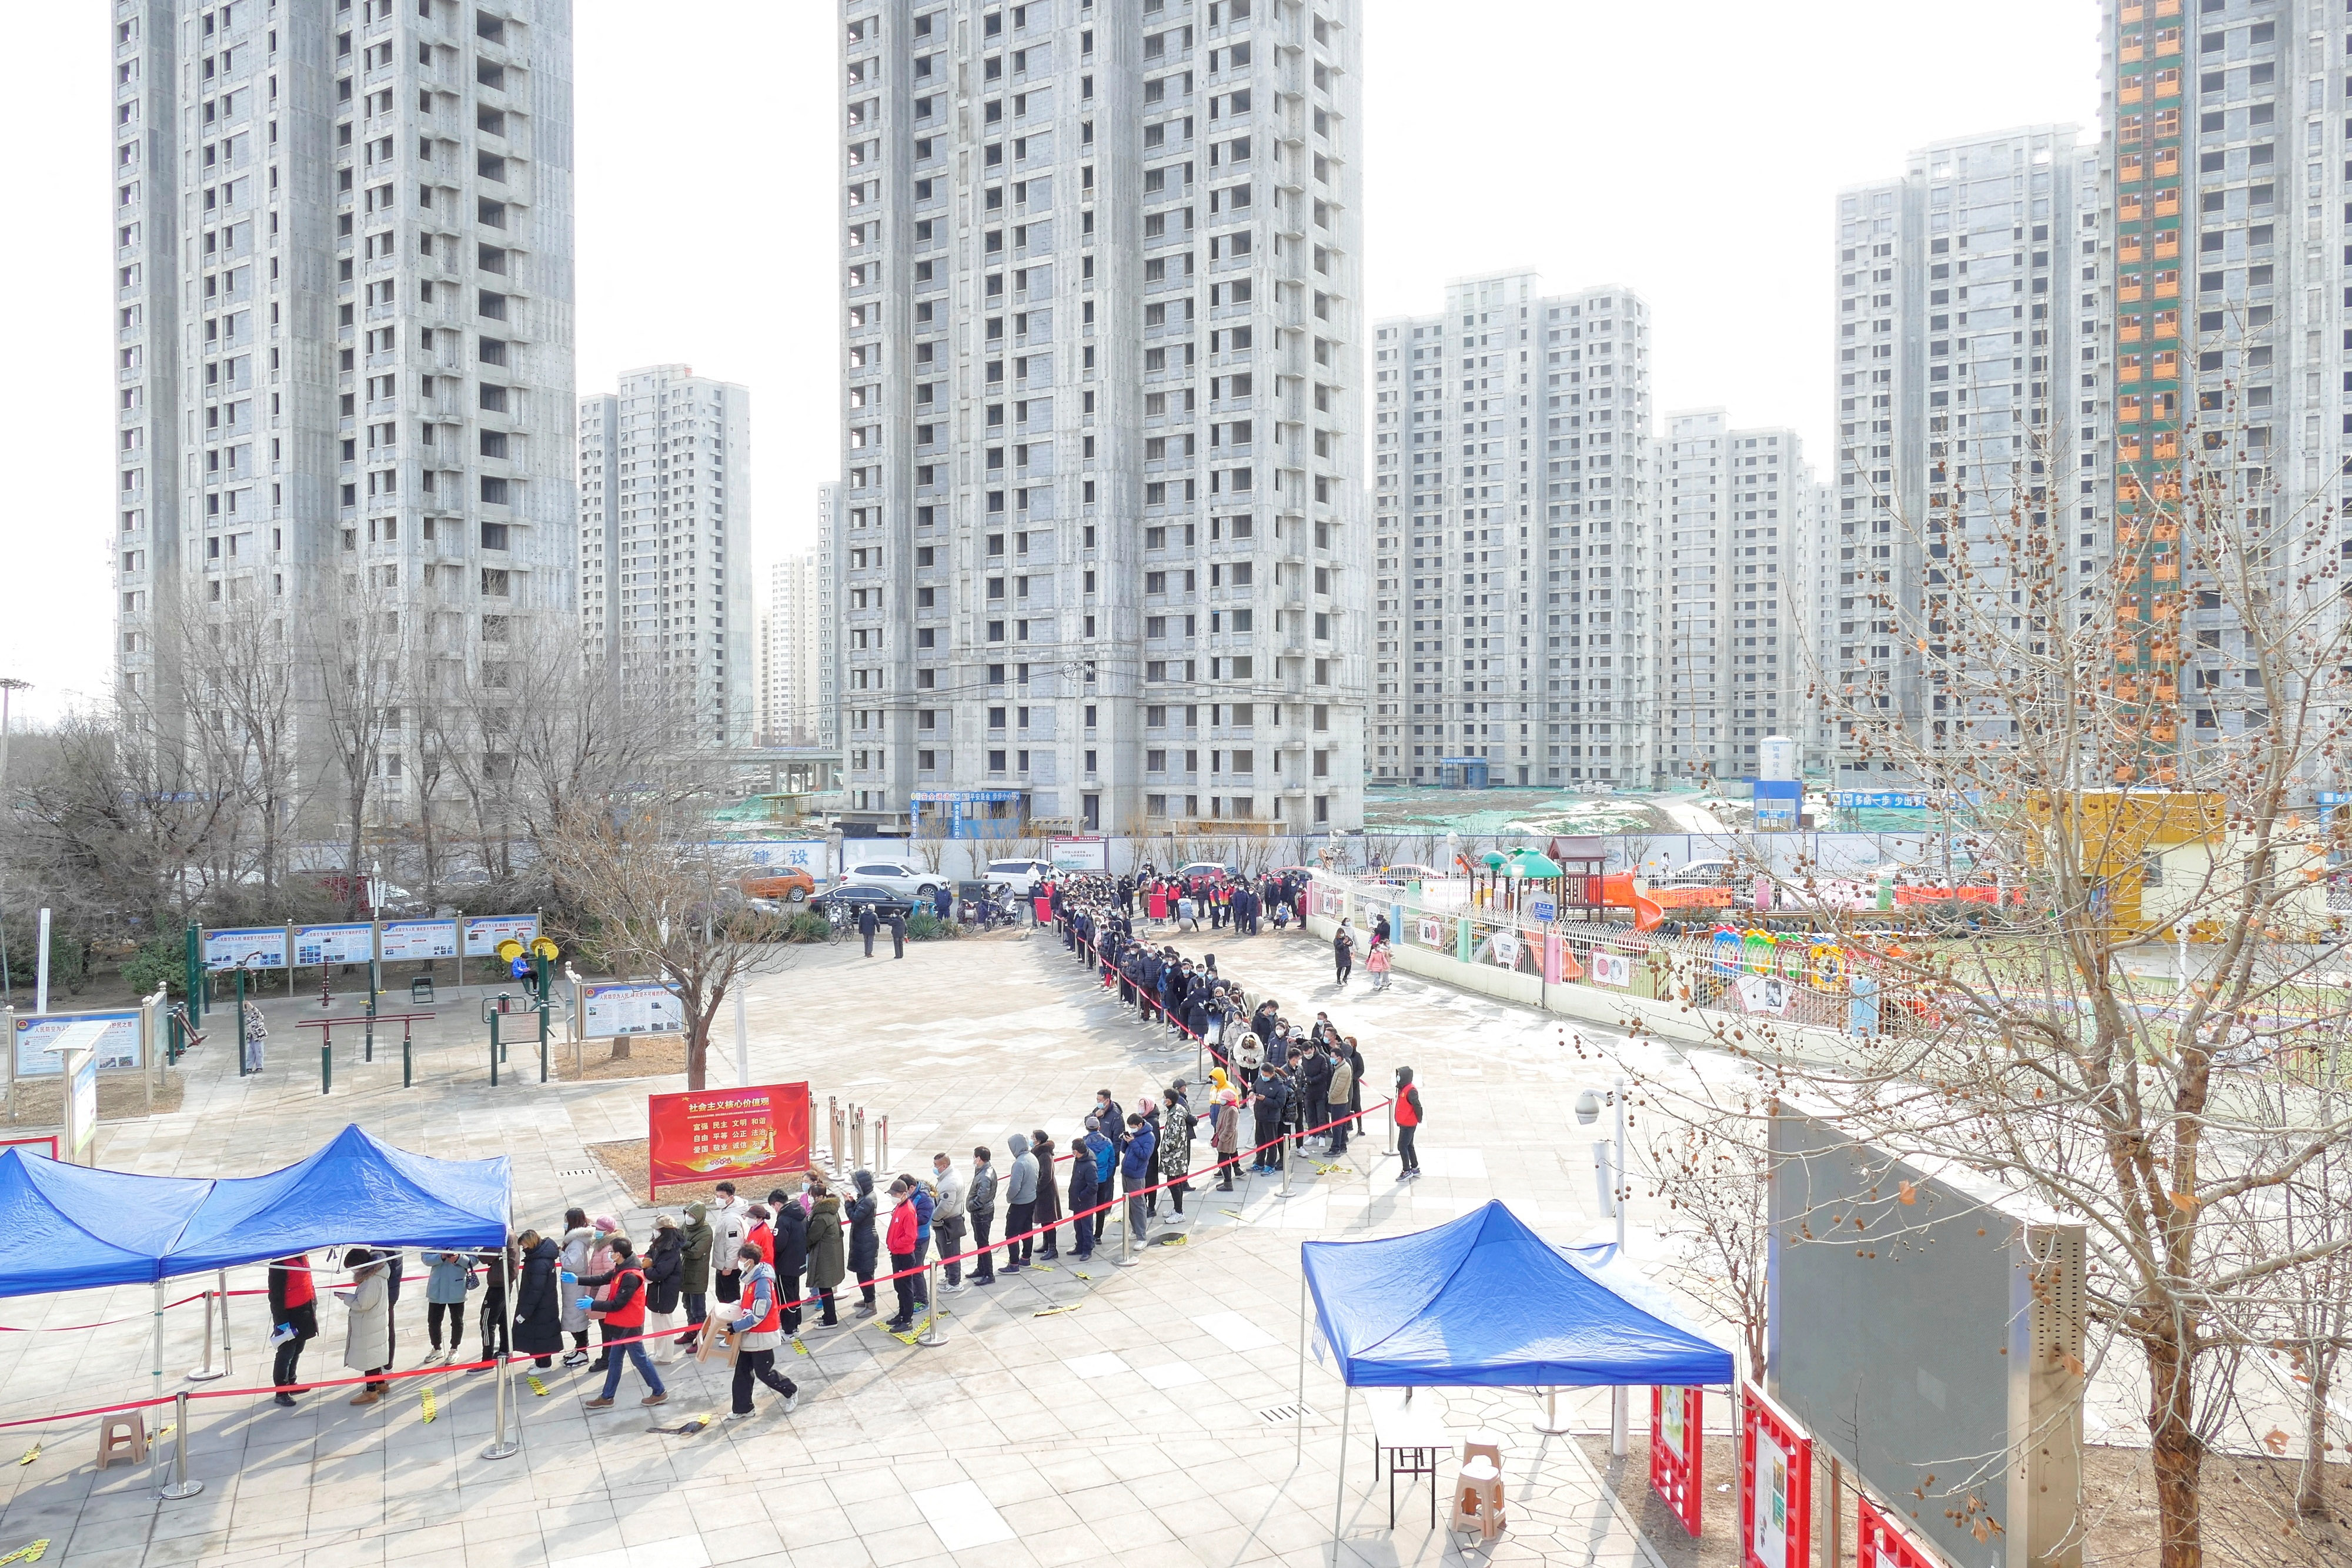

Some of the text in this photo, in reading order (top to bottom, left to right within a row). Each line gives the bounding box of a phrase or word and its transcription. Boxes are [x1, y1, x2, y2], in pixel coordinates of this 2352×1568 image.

[993, 792, 1012, 800] 步步小心
[1855, 794, 1889, 806] 多防一步
[631, 989, 677, 998] 就坚不可摧的护民之
[689, 1096, 770, 1113] 社会主义核心价值观
[693, 1117, 766, 1132] 富强 民主 文明 和谐
[693, 1128, 766, 1142] 自由 平等 公正 法治
[693, 1139, 766, 1154] 爱国 敬业 诚信 友善
